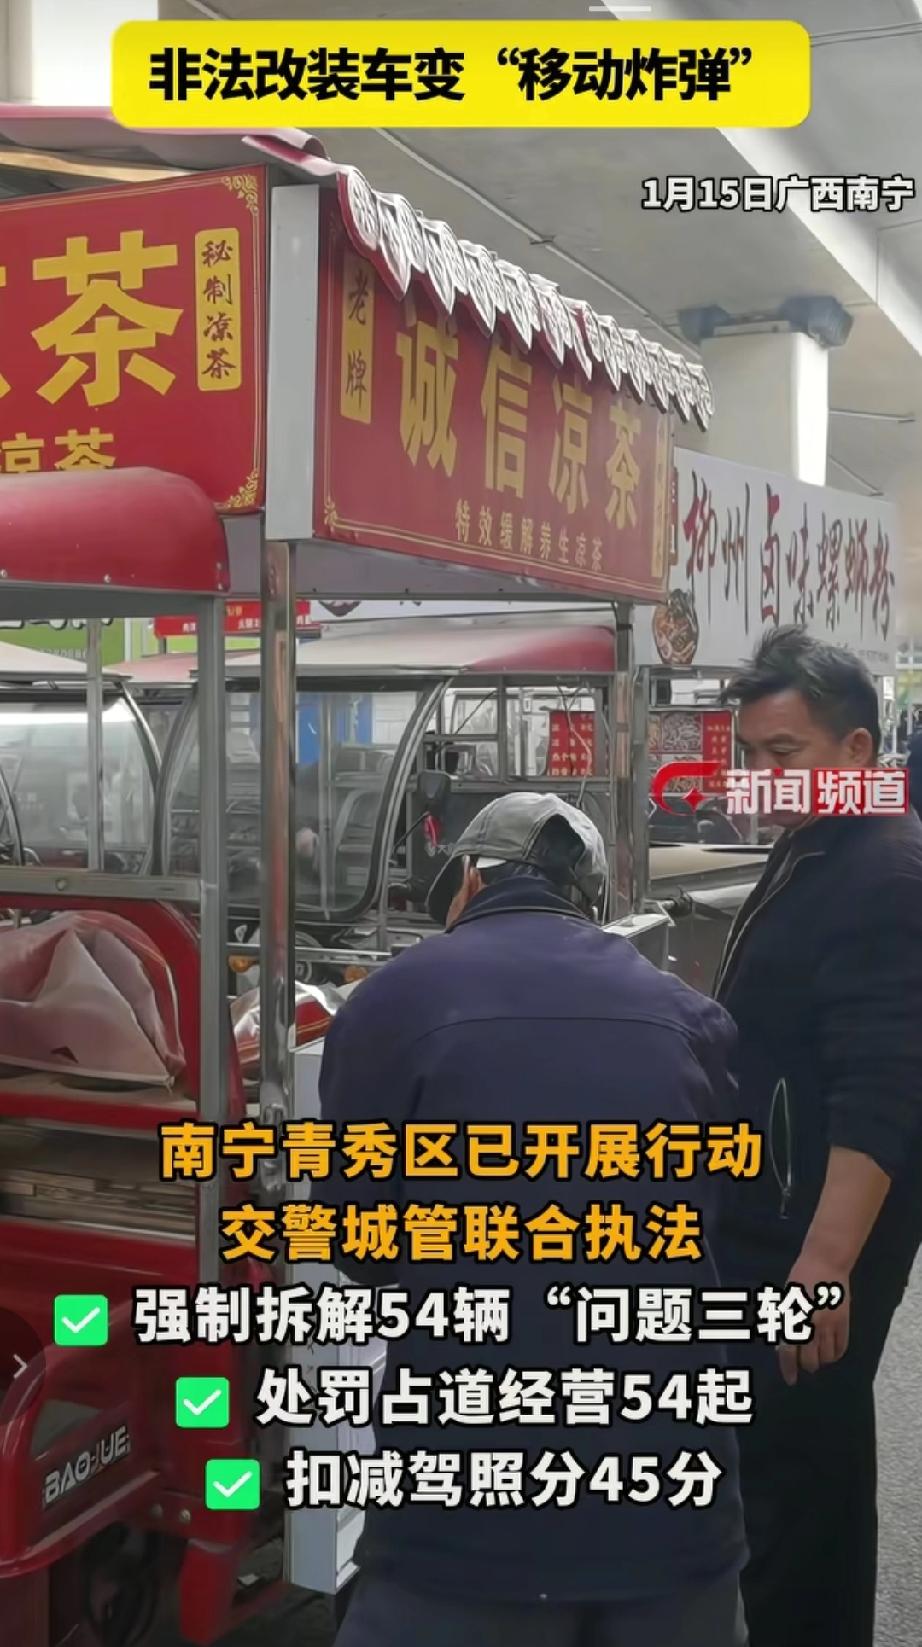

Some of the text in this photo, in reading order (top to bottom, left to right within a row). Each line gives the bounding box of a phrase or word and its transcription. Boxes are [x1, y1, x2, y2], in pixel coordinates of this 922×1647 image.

[0, 230, 184, 407] 茶
[201, 239, 236, 380] 秘制凉茶
[346, 267, 368, 413] 老牌
[395, 302, 641, 531] 诚信凉茶
[454, 498, 602, 572] 特效缓解养生凉茶
